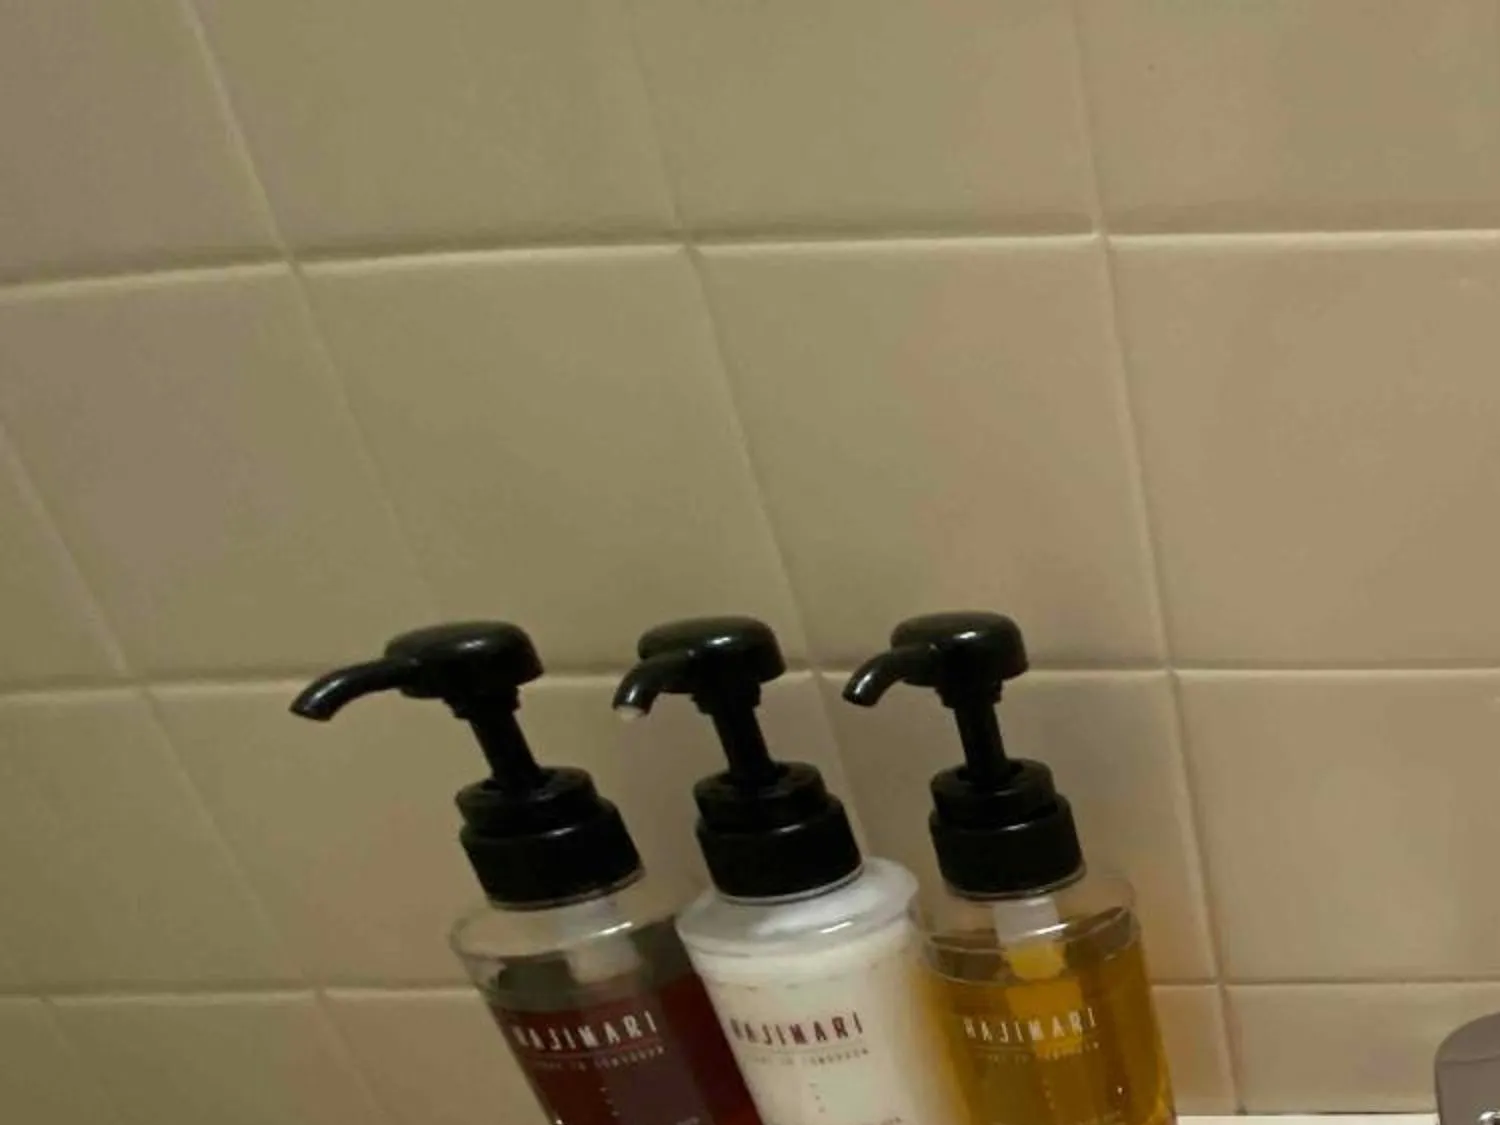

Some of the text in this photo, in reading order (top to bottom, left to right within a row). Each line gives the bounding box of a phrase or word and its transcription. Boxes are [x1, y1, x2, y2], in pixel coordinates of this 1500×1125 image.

[511, 1009, 657, 1051] HAJIMARI
[729, 1010, 864, 1046] HAJIMARI
[962, 1006, 1098, 1044] HAJIMARI
